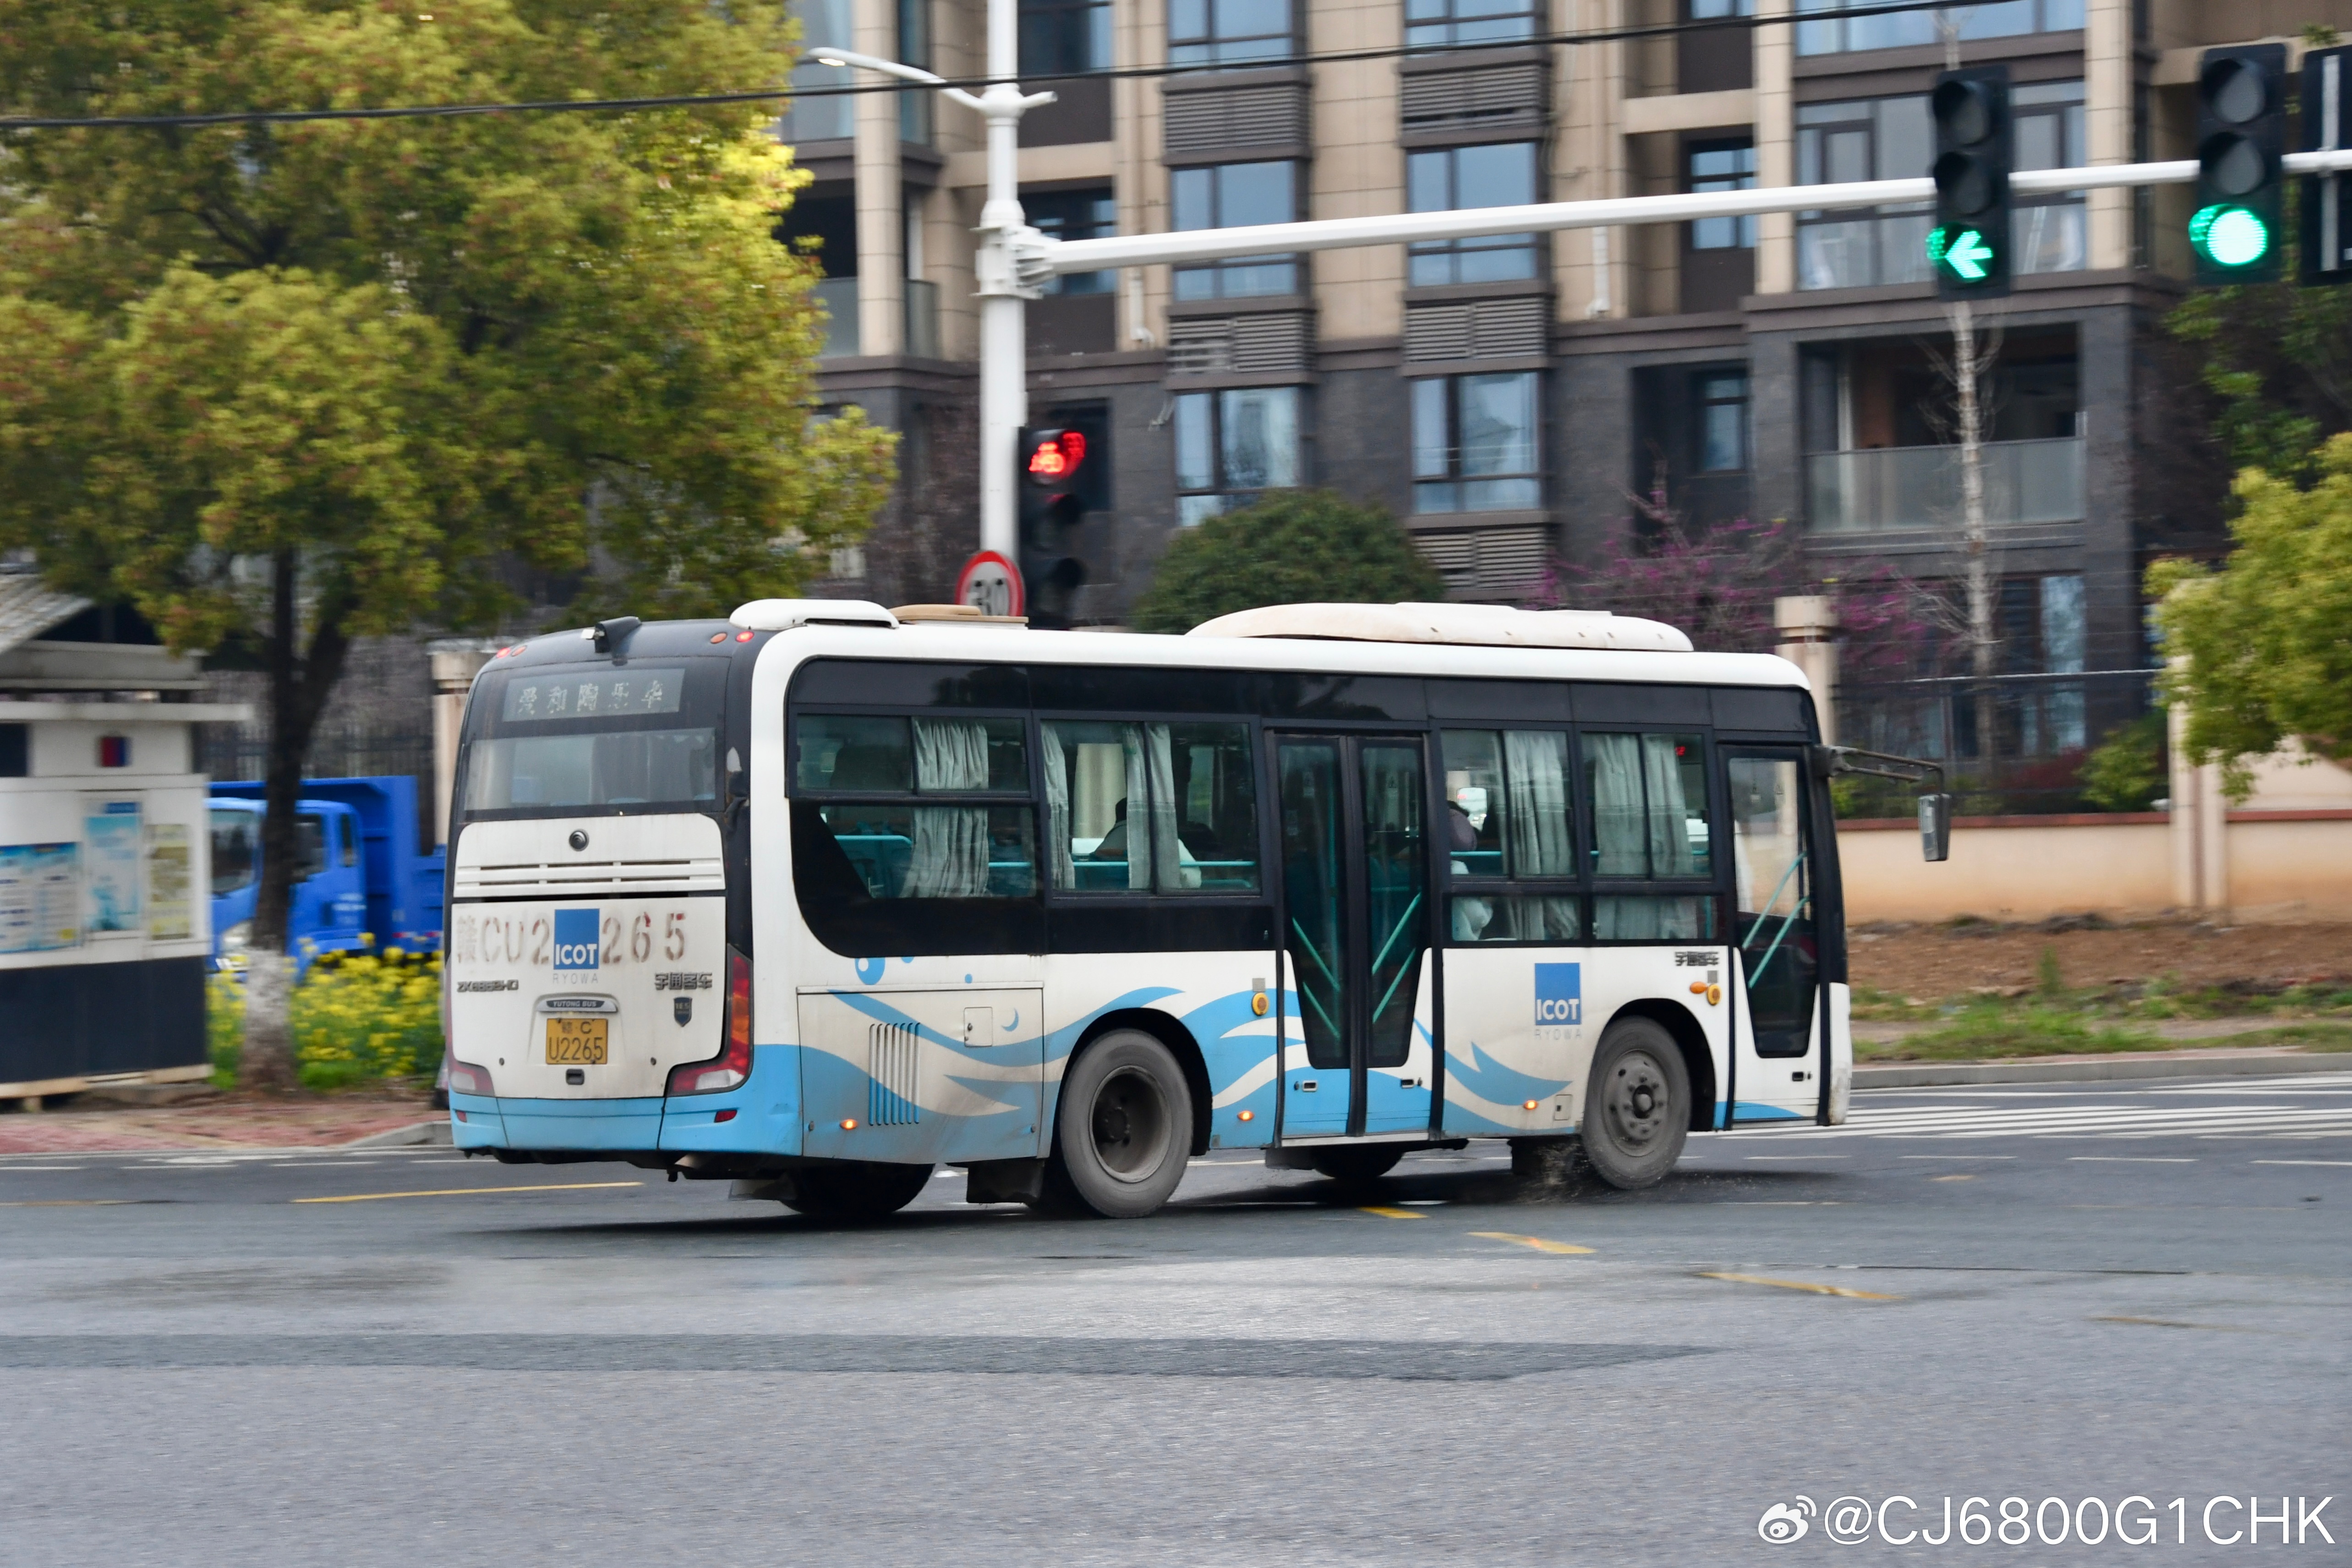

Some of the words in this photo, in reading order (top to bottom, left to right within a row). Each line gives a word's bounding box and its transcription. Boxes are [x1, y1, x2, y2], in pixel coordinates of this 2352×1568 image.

[555, 943, 597, 965] ICOT
[552, 972, 599, 984] RYOWA
[655, 972, 712, 990] 宇通客车
[1536, 998, 1580, 1021] ICOT
[1534, 1028, 1583, 1041] RYOWA
[549, 1037, 603, 1060] U2265
